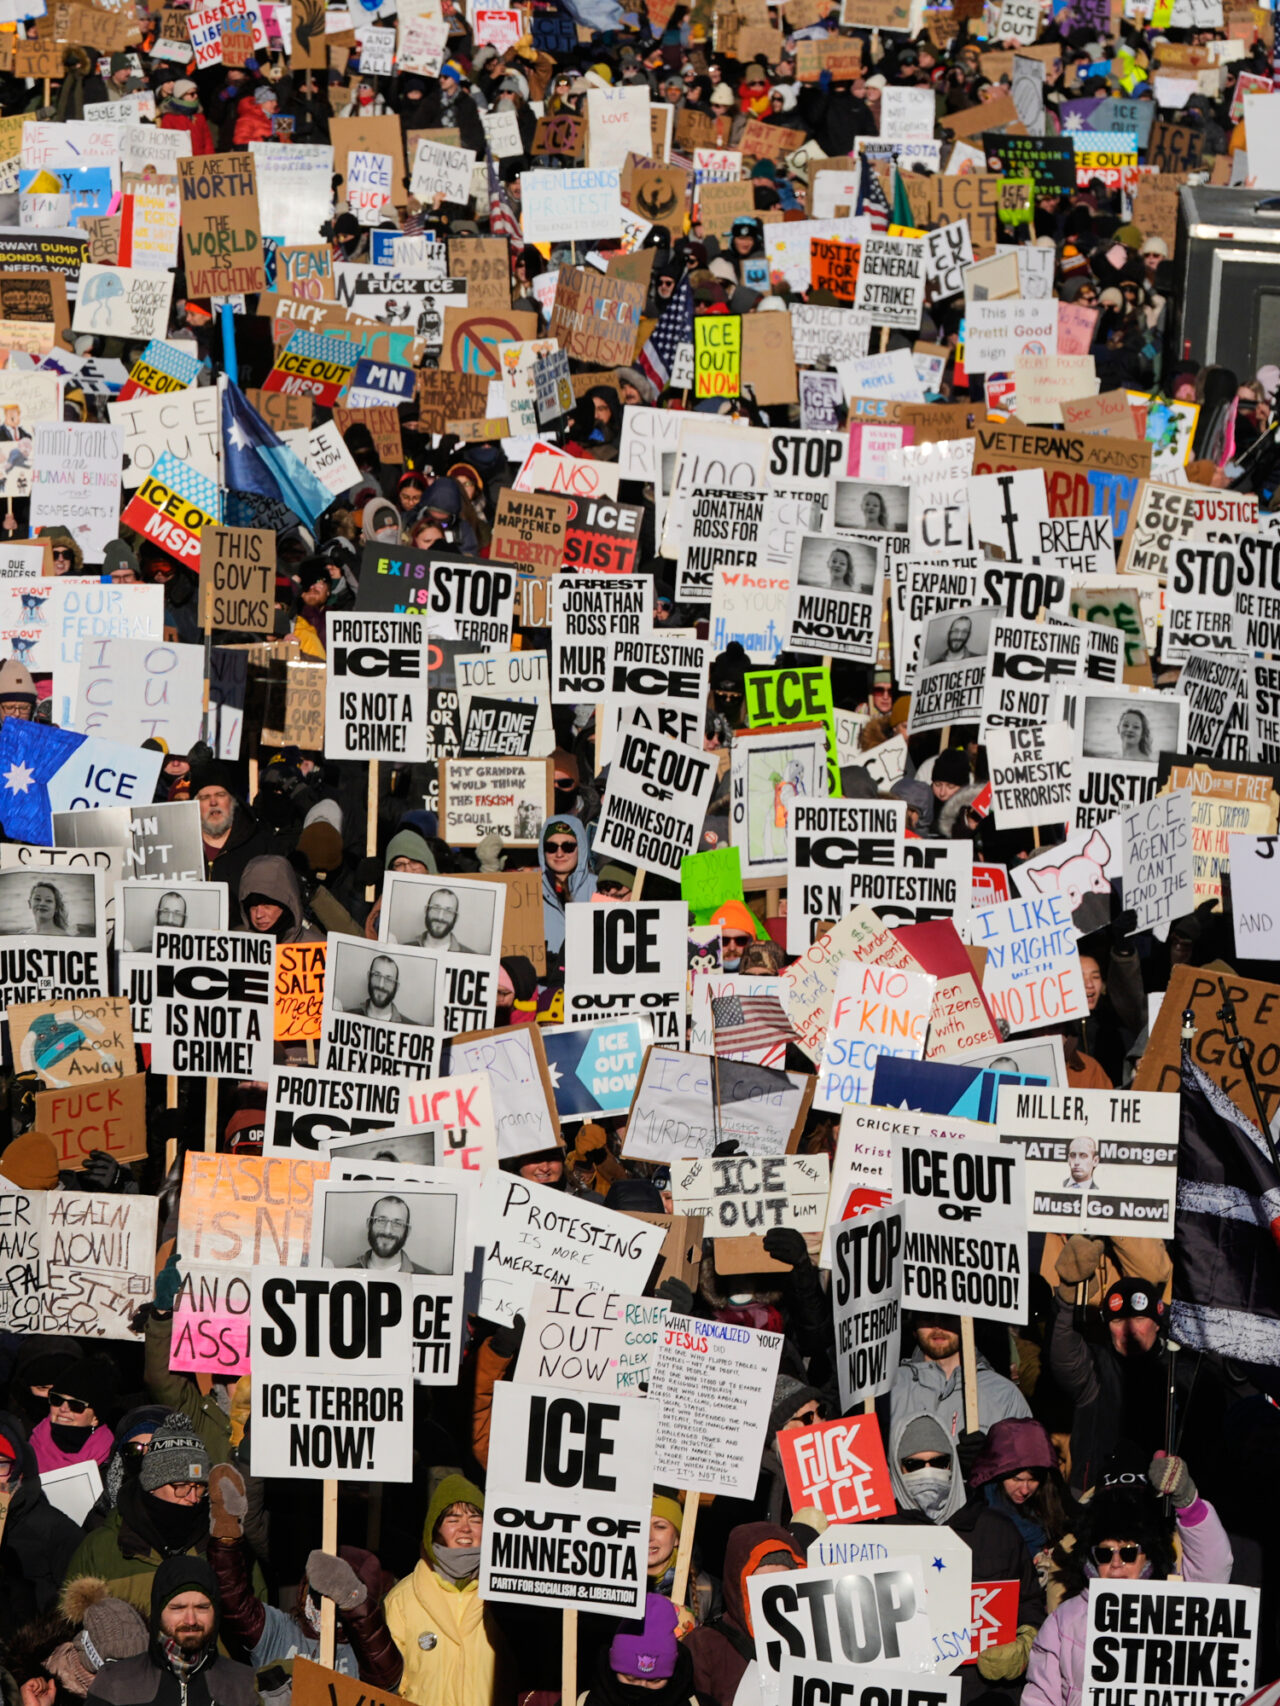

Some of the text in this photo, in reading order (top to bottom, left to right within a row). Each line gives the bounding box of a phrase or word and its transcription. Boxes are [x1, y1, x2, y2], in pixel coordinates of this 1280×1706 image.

[1005, 4, 1032, 19] ICE
[1001, 21, 1033, 39] OUT
[354, 154, 385, 170] MN
[697, 153, 736, 171] Vote
[183, 172, 254, 200] NORTH
[348, 167, 390, 186] NICE
[204, 214, 230, 231] THE
[187, 230, 258, 255] WORLD
[280, 250, 332, 281] YEAH
[864, 257, 920, 279] GENERAL
[190, 267, 264, 293] WATCHING
[863, 283, 916, 306] STRIKE!
[702, 324, 734, 346] ICE
[969, 324, 1052, 339] Pretti Good
[700, 351, 737, 372] OUT
[980, 346, 1006, 361] sign
[699, 374, 738, 394] NOW
[771, 435, 843, 477] STOP
[978, 430, 1150, 470] VETERANS AGAINST
[32, 470, 119, 488] HUMAN BEINGS
[36, 504, 114, 518] SCAPEGOATS!
[498, 514, 561, 535] HAPPENED
[507, 501, 556, 520] WHAT
[692, 500, 763, 522] JONATHAN
[693, 518, 757, 542] ROSS FOR
[1040, 517, 1112, 554] BREAK
[215, 531, 263, 561] THIS
[496, 537, 563, 563] LIBERTY
[213, 562, 272, 593] GOV'T
[213, 598, 268, 627] SUCKS
[798, 595, 872, 629] MURDER
[332, 619, 421, 644] PROTESTING
[793, 620, 873, 644] NOW!
[334, 647, 420, 678] ICE
[345, 723, 407, 753] CRIME!
[607, 795, 694, 845] MINNESOTA
[156, 933, 272, 966] PROTESTING
[593, 908, 660, 975] ICE
[1011, 927, 1078, 966] RIGHTS
[173, 1040, 254, 1075] CRIME!
[52, 1089, 123, 1123] FUCK
[1017, 1093, 1141, 1127] MILLER, THE
[1100, 1144, 1177, 1163] Monger
[902, 1147, 1016, 1205] ICE OUT
[503, 1182, 647, 1260] PROTESTING
[938, 1203, 982, 1222] OF
[1034, 1196, 1169, 1219] Must Go Now!
[904, 1232, 1020, 1274] MINNESOTA
[261, 1277, 403, 1361] STOP
[664, 1317, 780, 1350] WHAT RADICALIZED YOU?
[664, 1330, 708, 1353] JESUS
[262, 1384, 404, 1422] ICE TERROR
[289, 1424, 375, 1470] NOW!
[493, 1507, 641, 1539] OUT OF
[491, 1532, 638, 1582] MINNESOTA
[1095, 1592, 1251, 1639] GENERAL
[1091, 1636, 1250, 1688] STRIKE:
